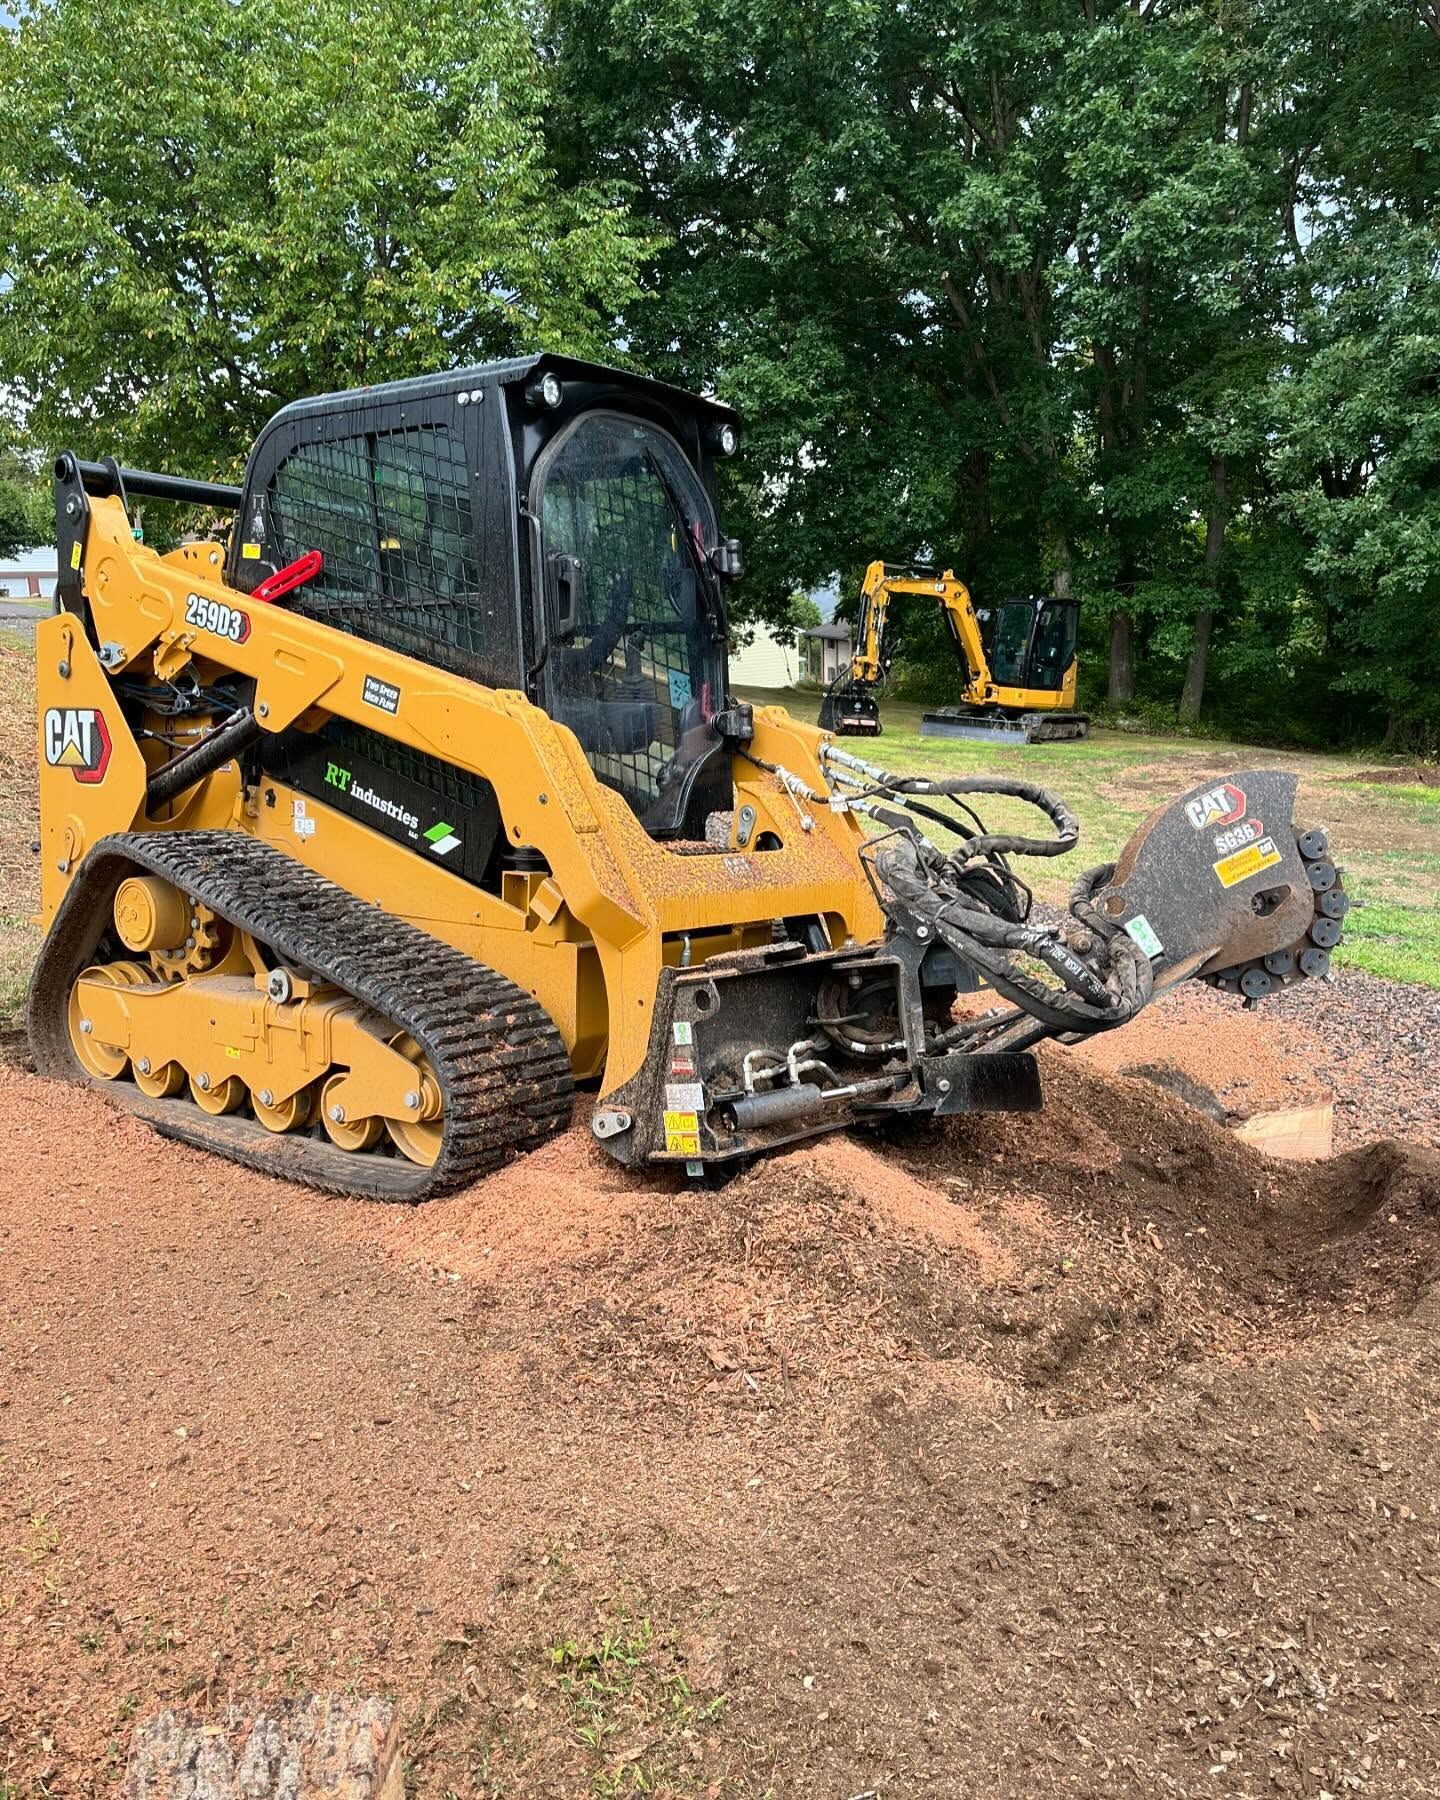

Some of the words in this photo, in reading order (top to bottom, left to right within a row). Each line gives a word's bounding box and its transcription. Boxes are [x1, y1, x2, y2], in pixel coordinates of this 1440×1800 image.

[185, 592, 242, 641] 259D3
[45, 708, 96, 767] CAT
[324, 761, 351, 791] RT
[350, 779, 419, 829] industries
[1184, 787, 1232, 828] CAT
[1214, 822, 1256, 853] SG36
